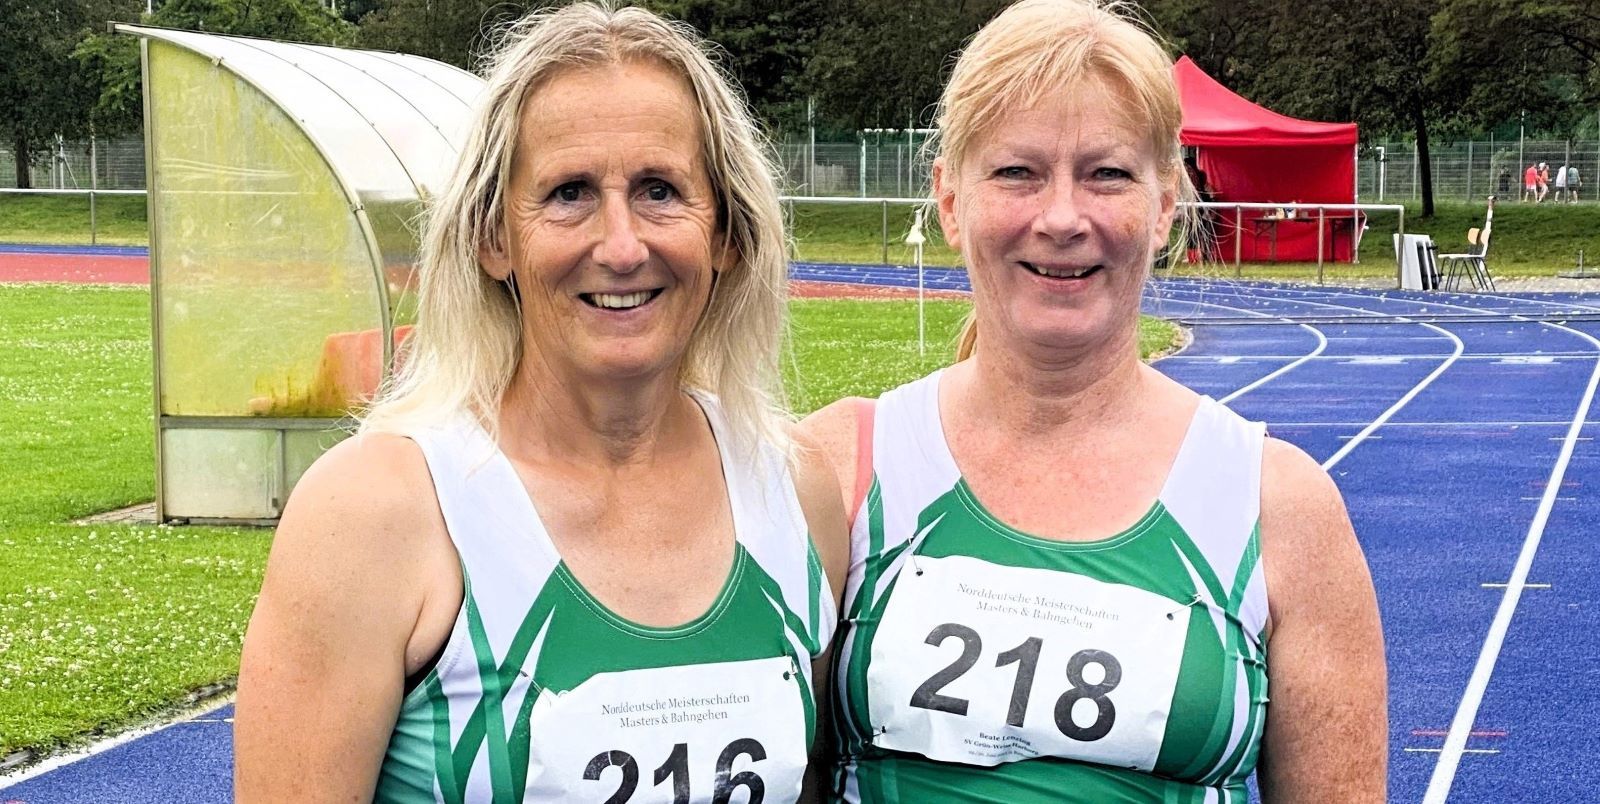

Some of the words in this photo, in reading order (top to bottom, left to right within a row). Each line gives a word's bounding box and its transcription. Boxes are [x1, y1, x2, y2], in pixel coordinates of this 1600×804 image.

[957, 582, 1031, 604] Norddeutsche
[1034, 595, 1119, 621] Meisterschaften
[976, 601, 1018, 616] Masters
[1020, 606, 1030, 617] &
[1033, 608, 1093, 630] Bahngehen
[909, 622, 1122, 742] 218
[601, 698, 667, 715] Norddeutsche
[668, 692, 750, 709] Meisterschaften
[620, 717, 660, 728] Masters
[661, 714, 669, 724] &
[671, 709, 728, 724] Bahngehen
[582, 737, 767, 804] 216
